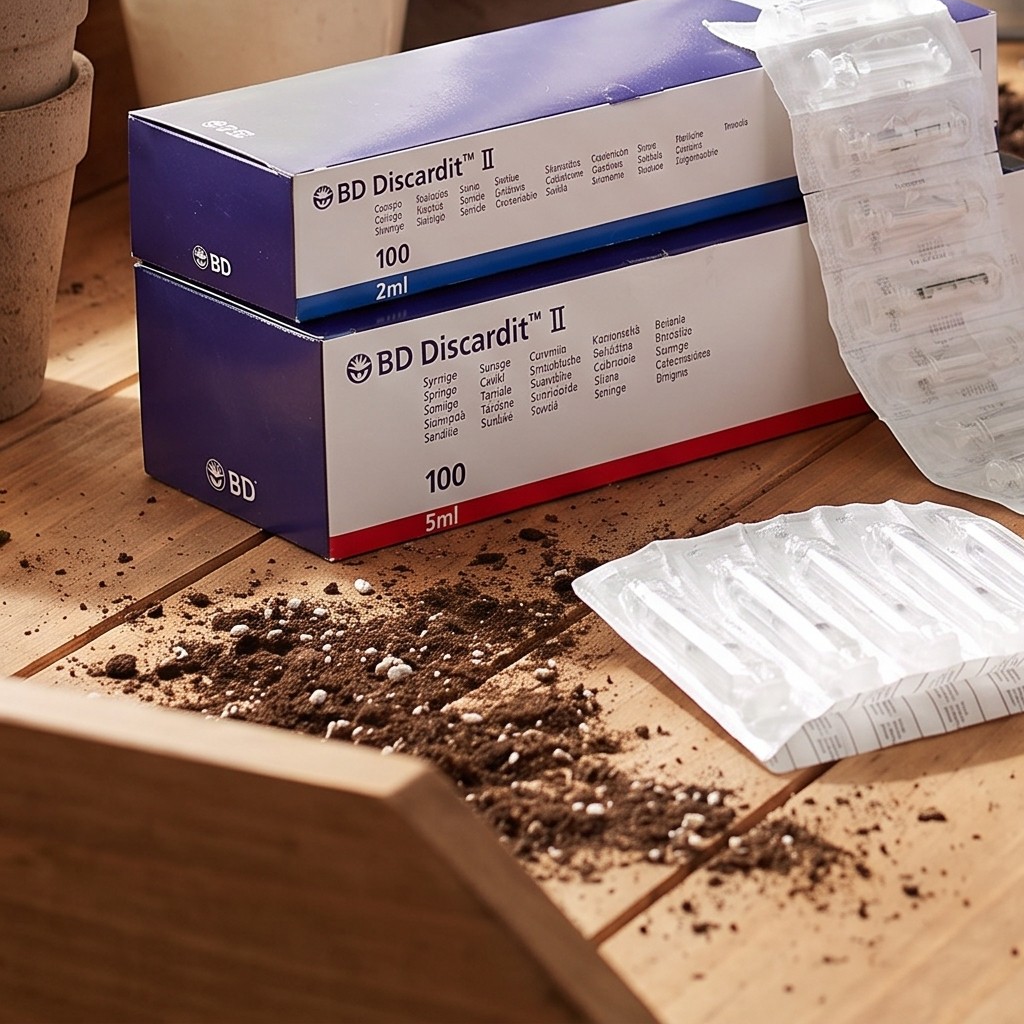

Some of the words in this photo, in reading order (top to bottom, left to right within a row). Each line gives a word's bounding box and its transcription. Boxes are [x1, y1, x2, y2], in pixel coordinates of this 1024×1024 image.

[338, 179, 367, 204] BD
[481, 147, 495, 171] II
[209, 252, 232, 277] BD
[376, 243, 410, 269] 100
[376, 275, 408, 301] 2ml
[376, 346, 413, 376] BD
[549, 305, 567, 334] II
[228, 469, 256, 502] BD
[425, 462, 466, 494] 100
[425, 505, 458, 532] 5ml
